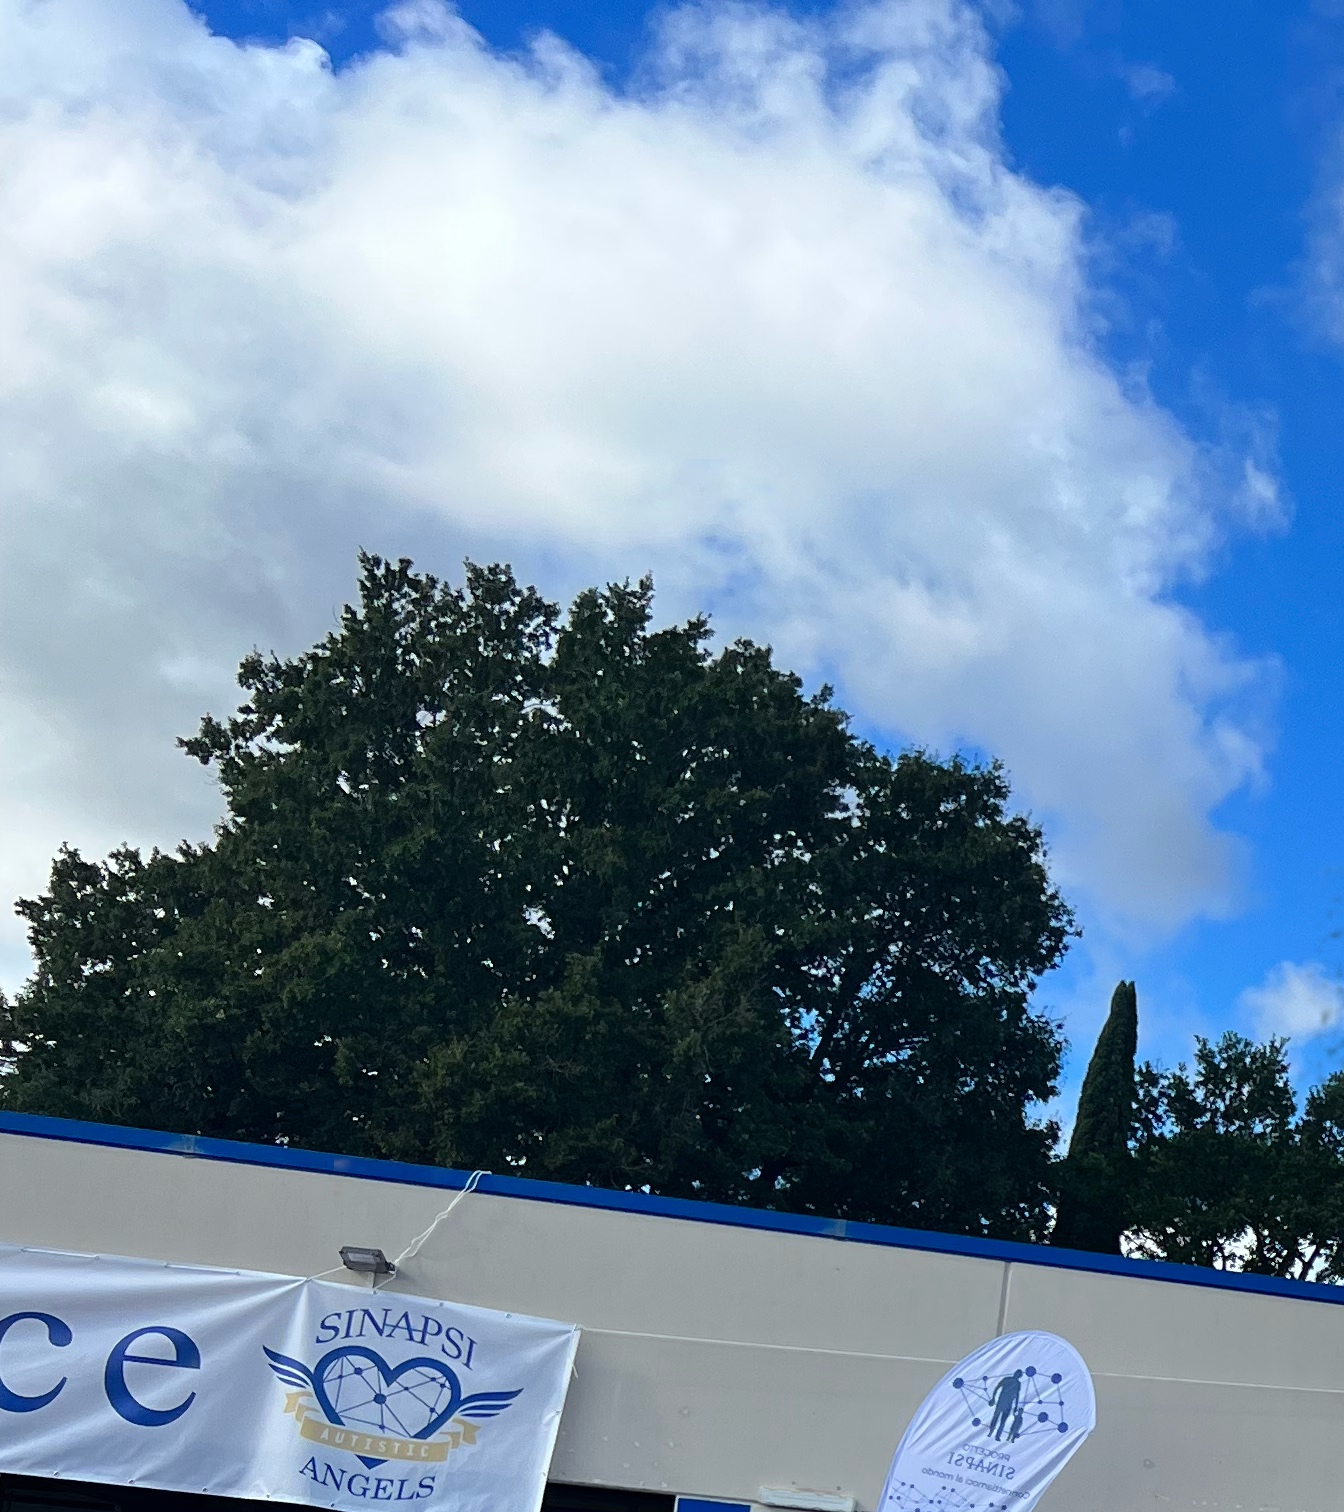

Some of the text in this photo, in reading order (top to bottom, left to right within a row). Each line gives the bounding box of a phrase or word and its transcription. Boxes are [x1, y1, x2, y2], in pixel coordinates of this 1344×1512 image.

[315, 1308, 478, 1371] SINAPSI
[320, 1428, 430, 1457] AUTISTIC
[299, 1456, 436, 1501] ANGELS
